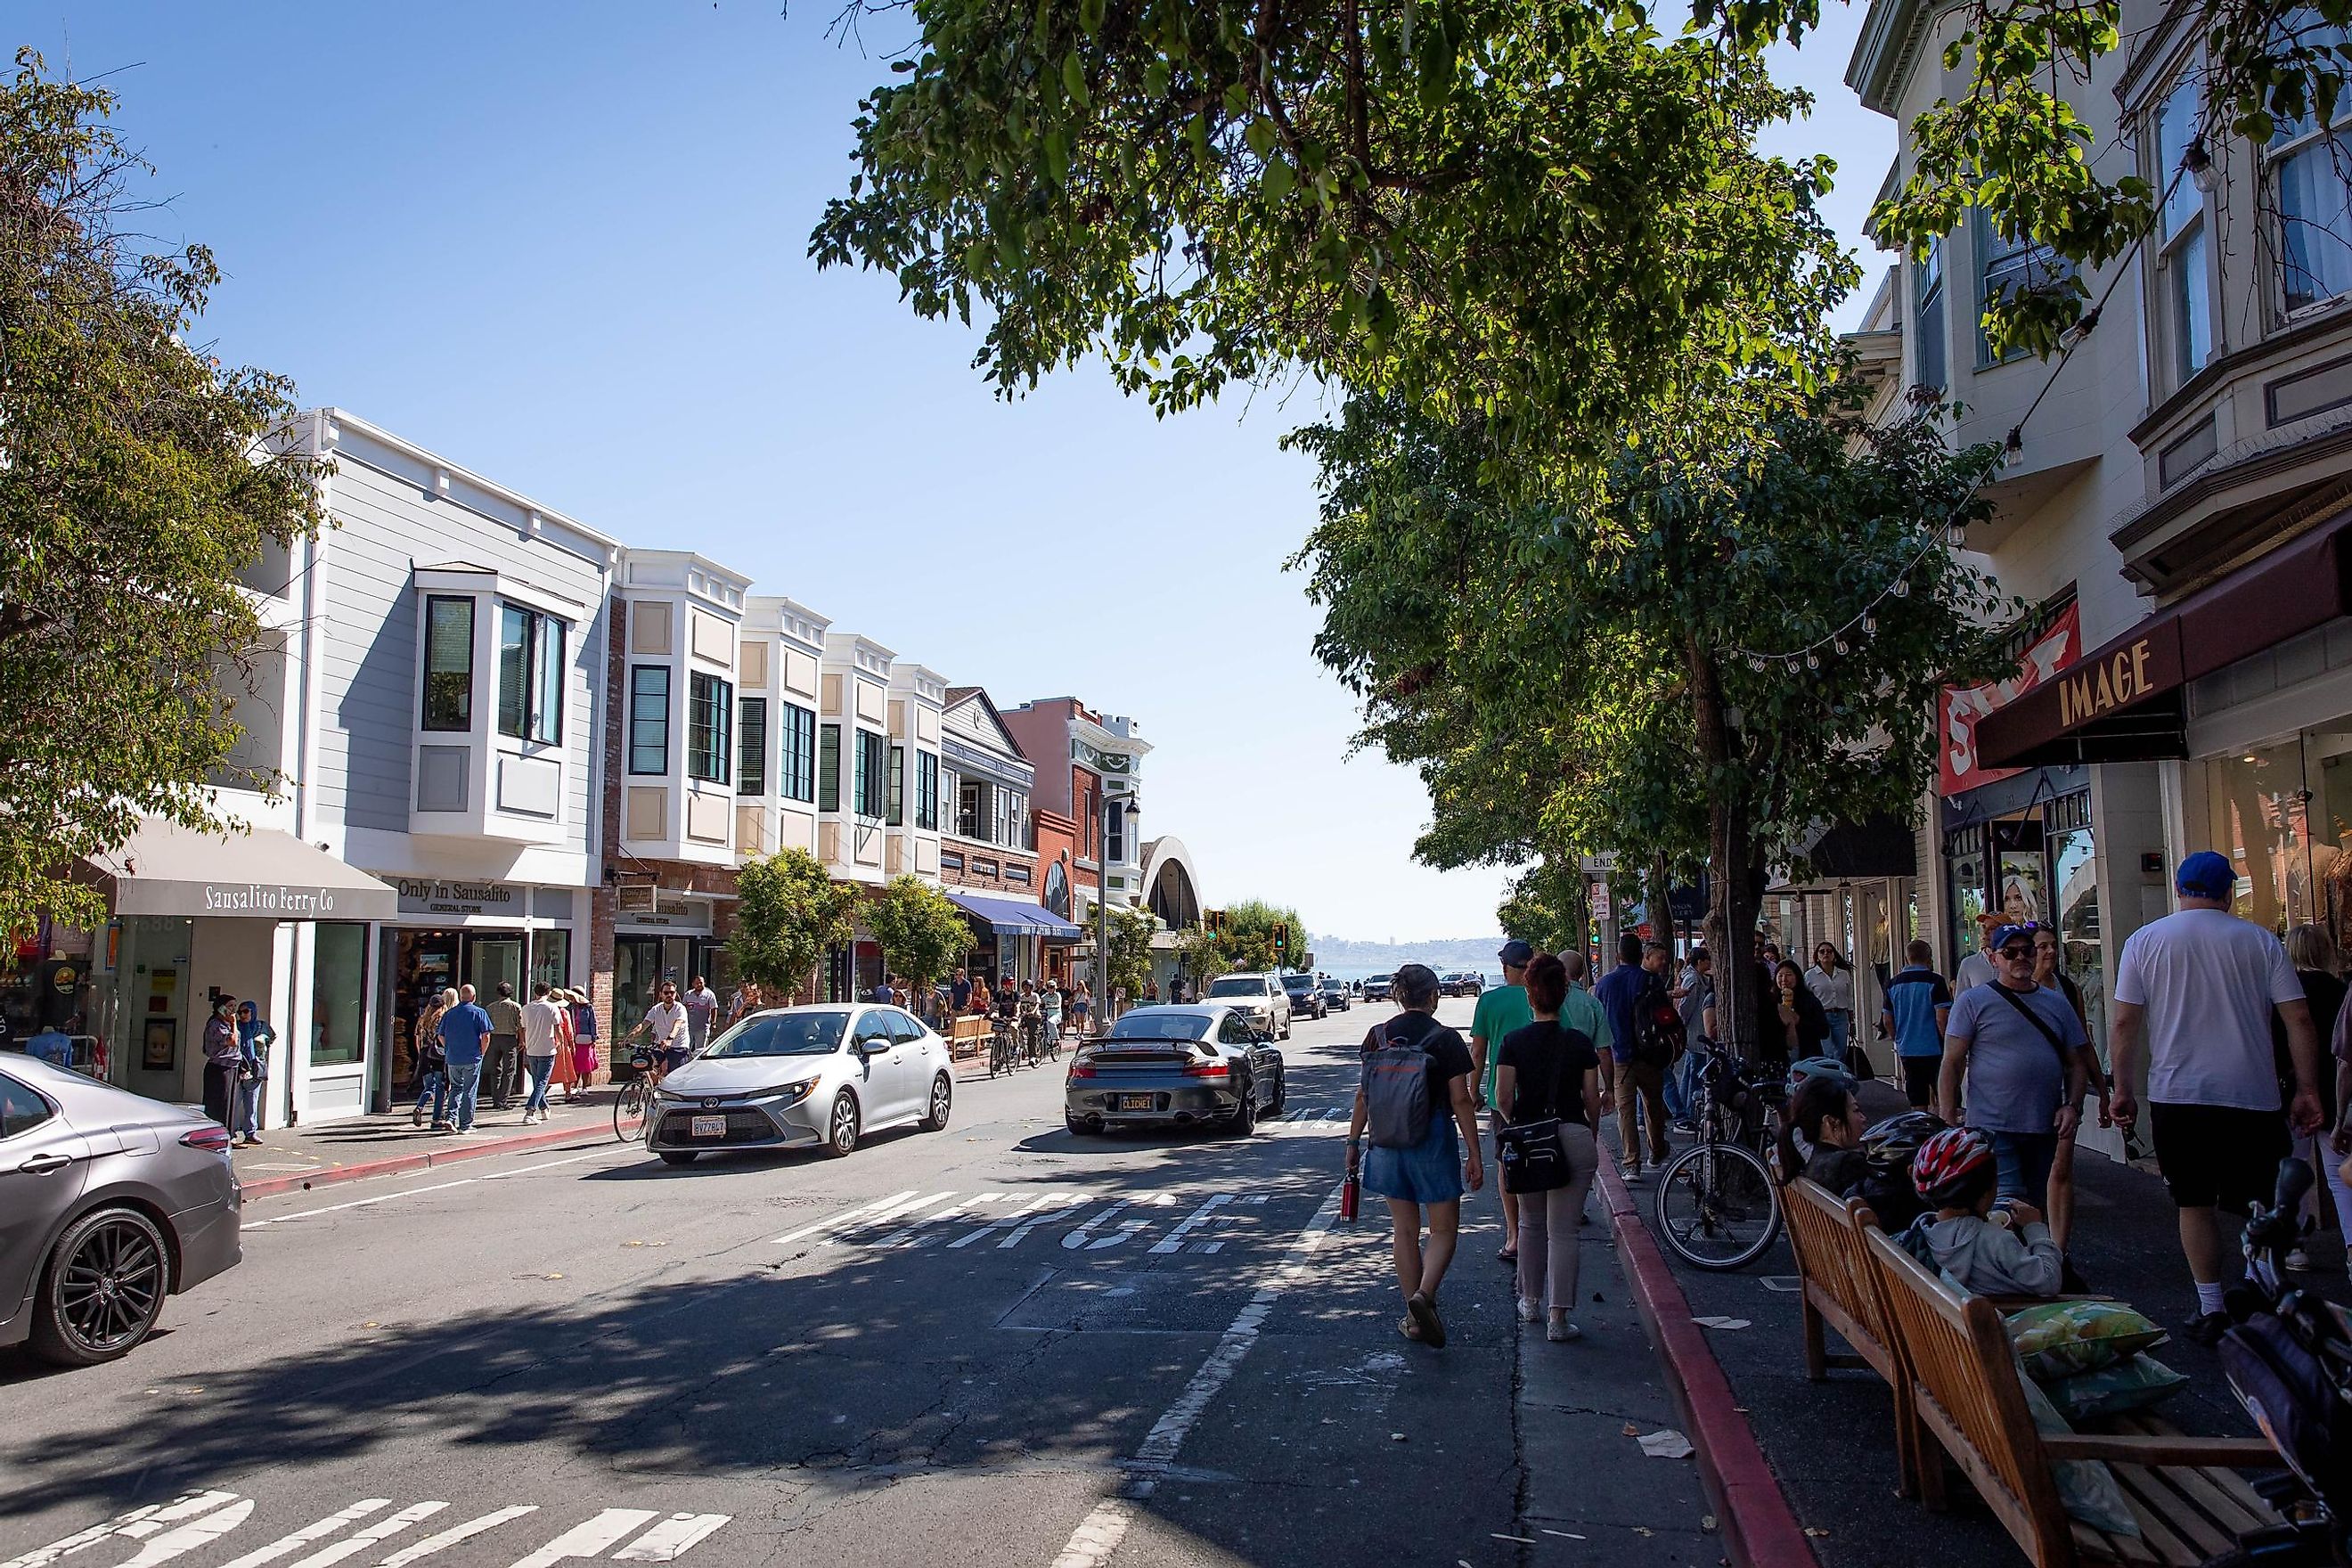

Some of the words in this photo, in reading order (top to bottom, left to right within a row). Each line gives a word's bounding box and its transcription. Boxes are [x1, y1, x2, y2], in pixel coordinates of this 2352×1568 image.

[2058, 639, 2153, 727] IMAGE
[206, 884, 276, 910] Sausalito
[280, 886, 316, 919] Ferry
[320, 887, 334, 911] Co
[397, 879, 430, 902] Only
[453, 883, 510, 902] Sausalito
[769, 1190, 1271, 1254] MERGE
